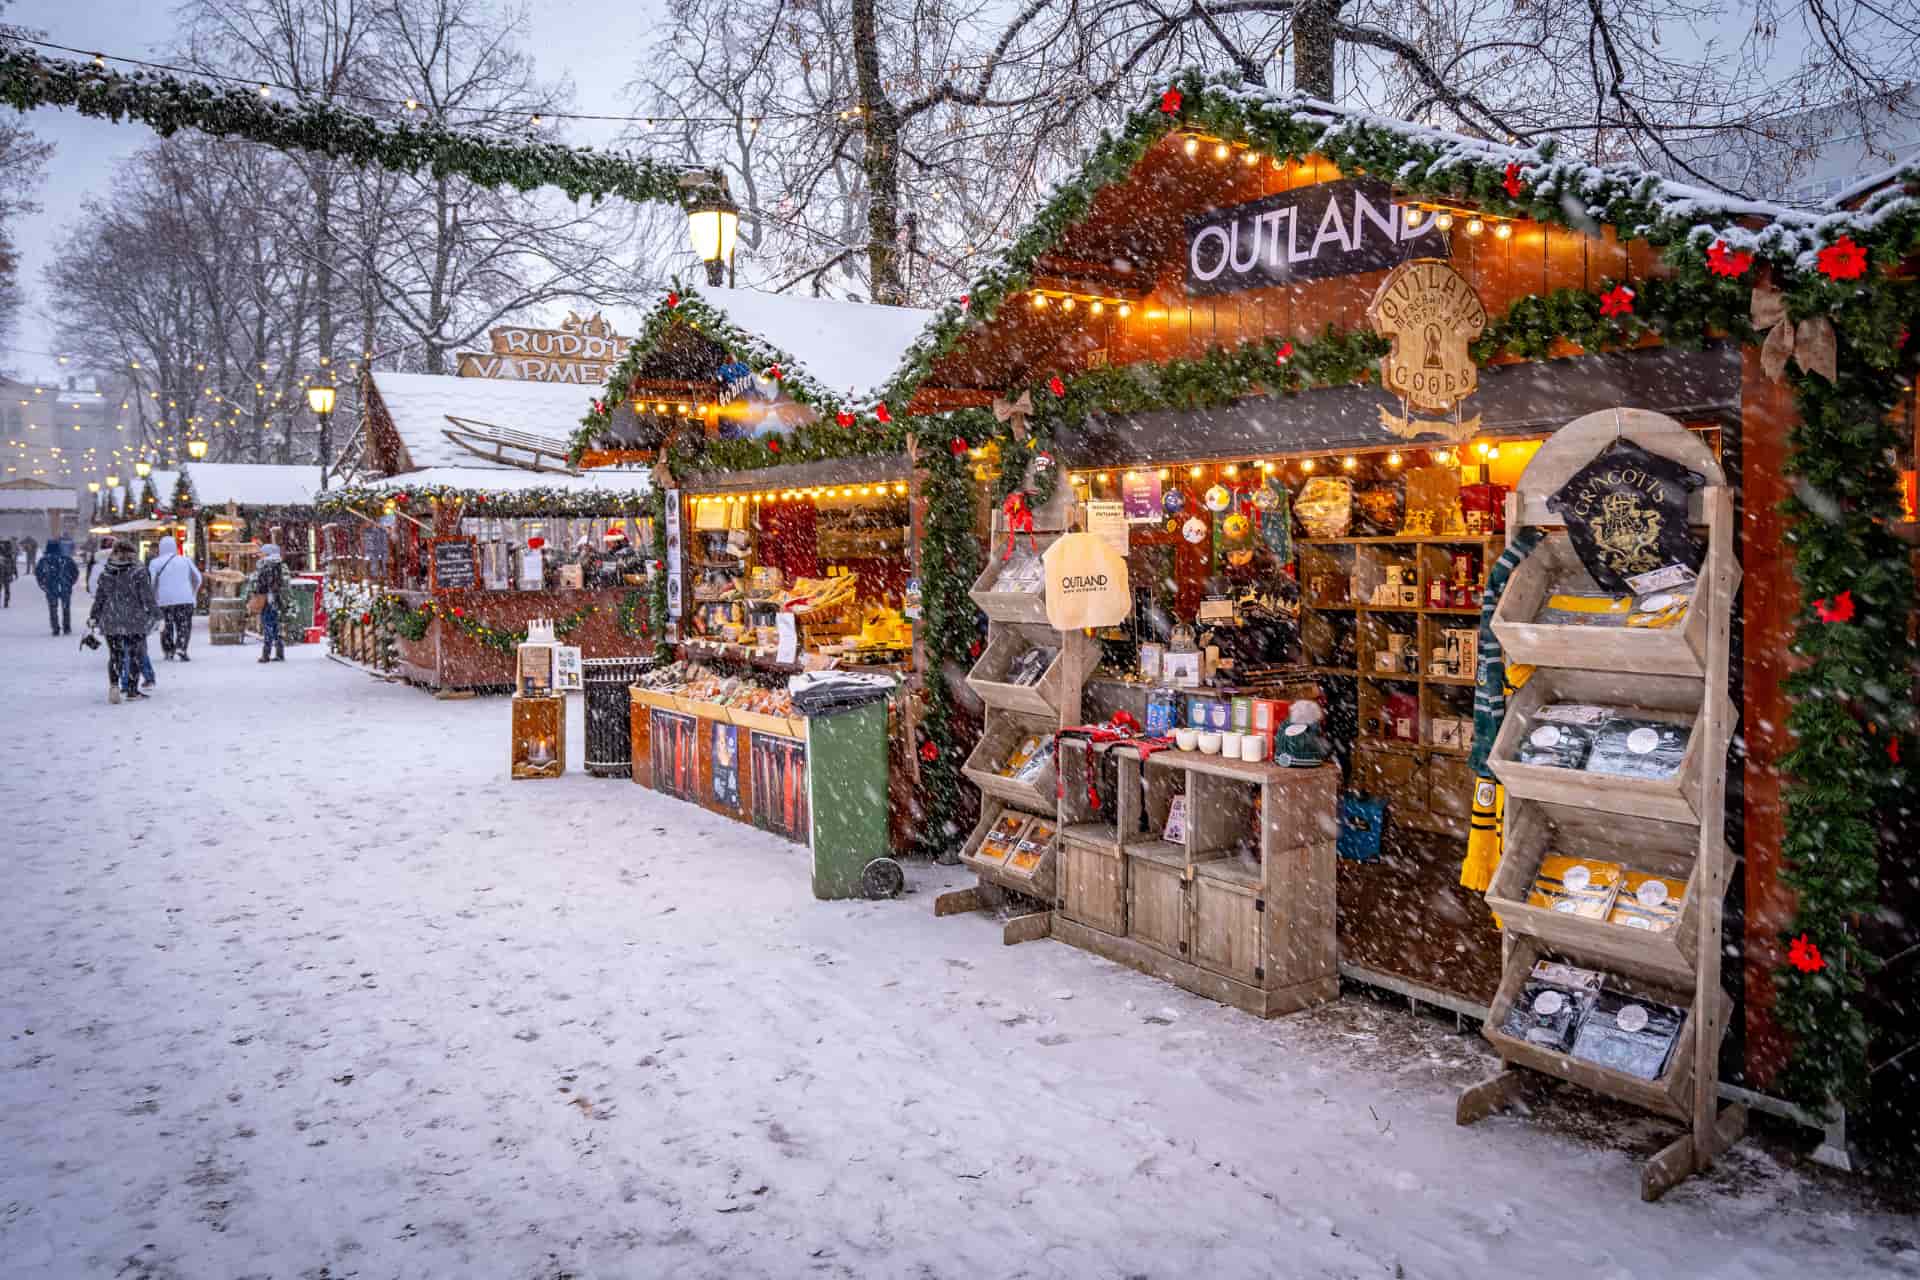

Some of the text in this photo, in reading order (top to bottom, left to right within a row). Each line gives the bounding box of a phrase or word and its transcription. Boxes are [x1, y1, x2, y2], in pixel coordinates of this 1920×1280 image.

[1190, 190, 1440, 281] OUTLAND
[1381, 265, 1483, 329] OUTLAND
[502, 329, 638, 359] RUDOL
[1395, 366, 1469, 395] GOODS
[1062, 574, 1108, 589] OUTLAND
